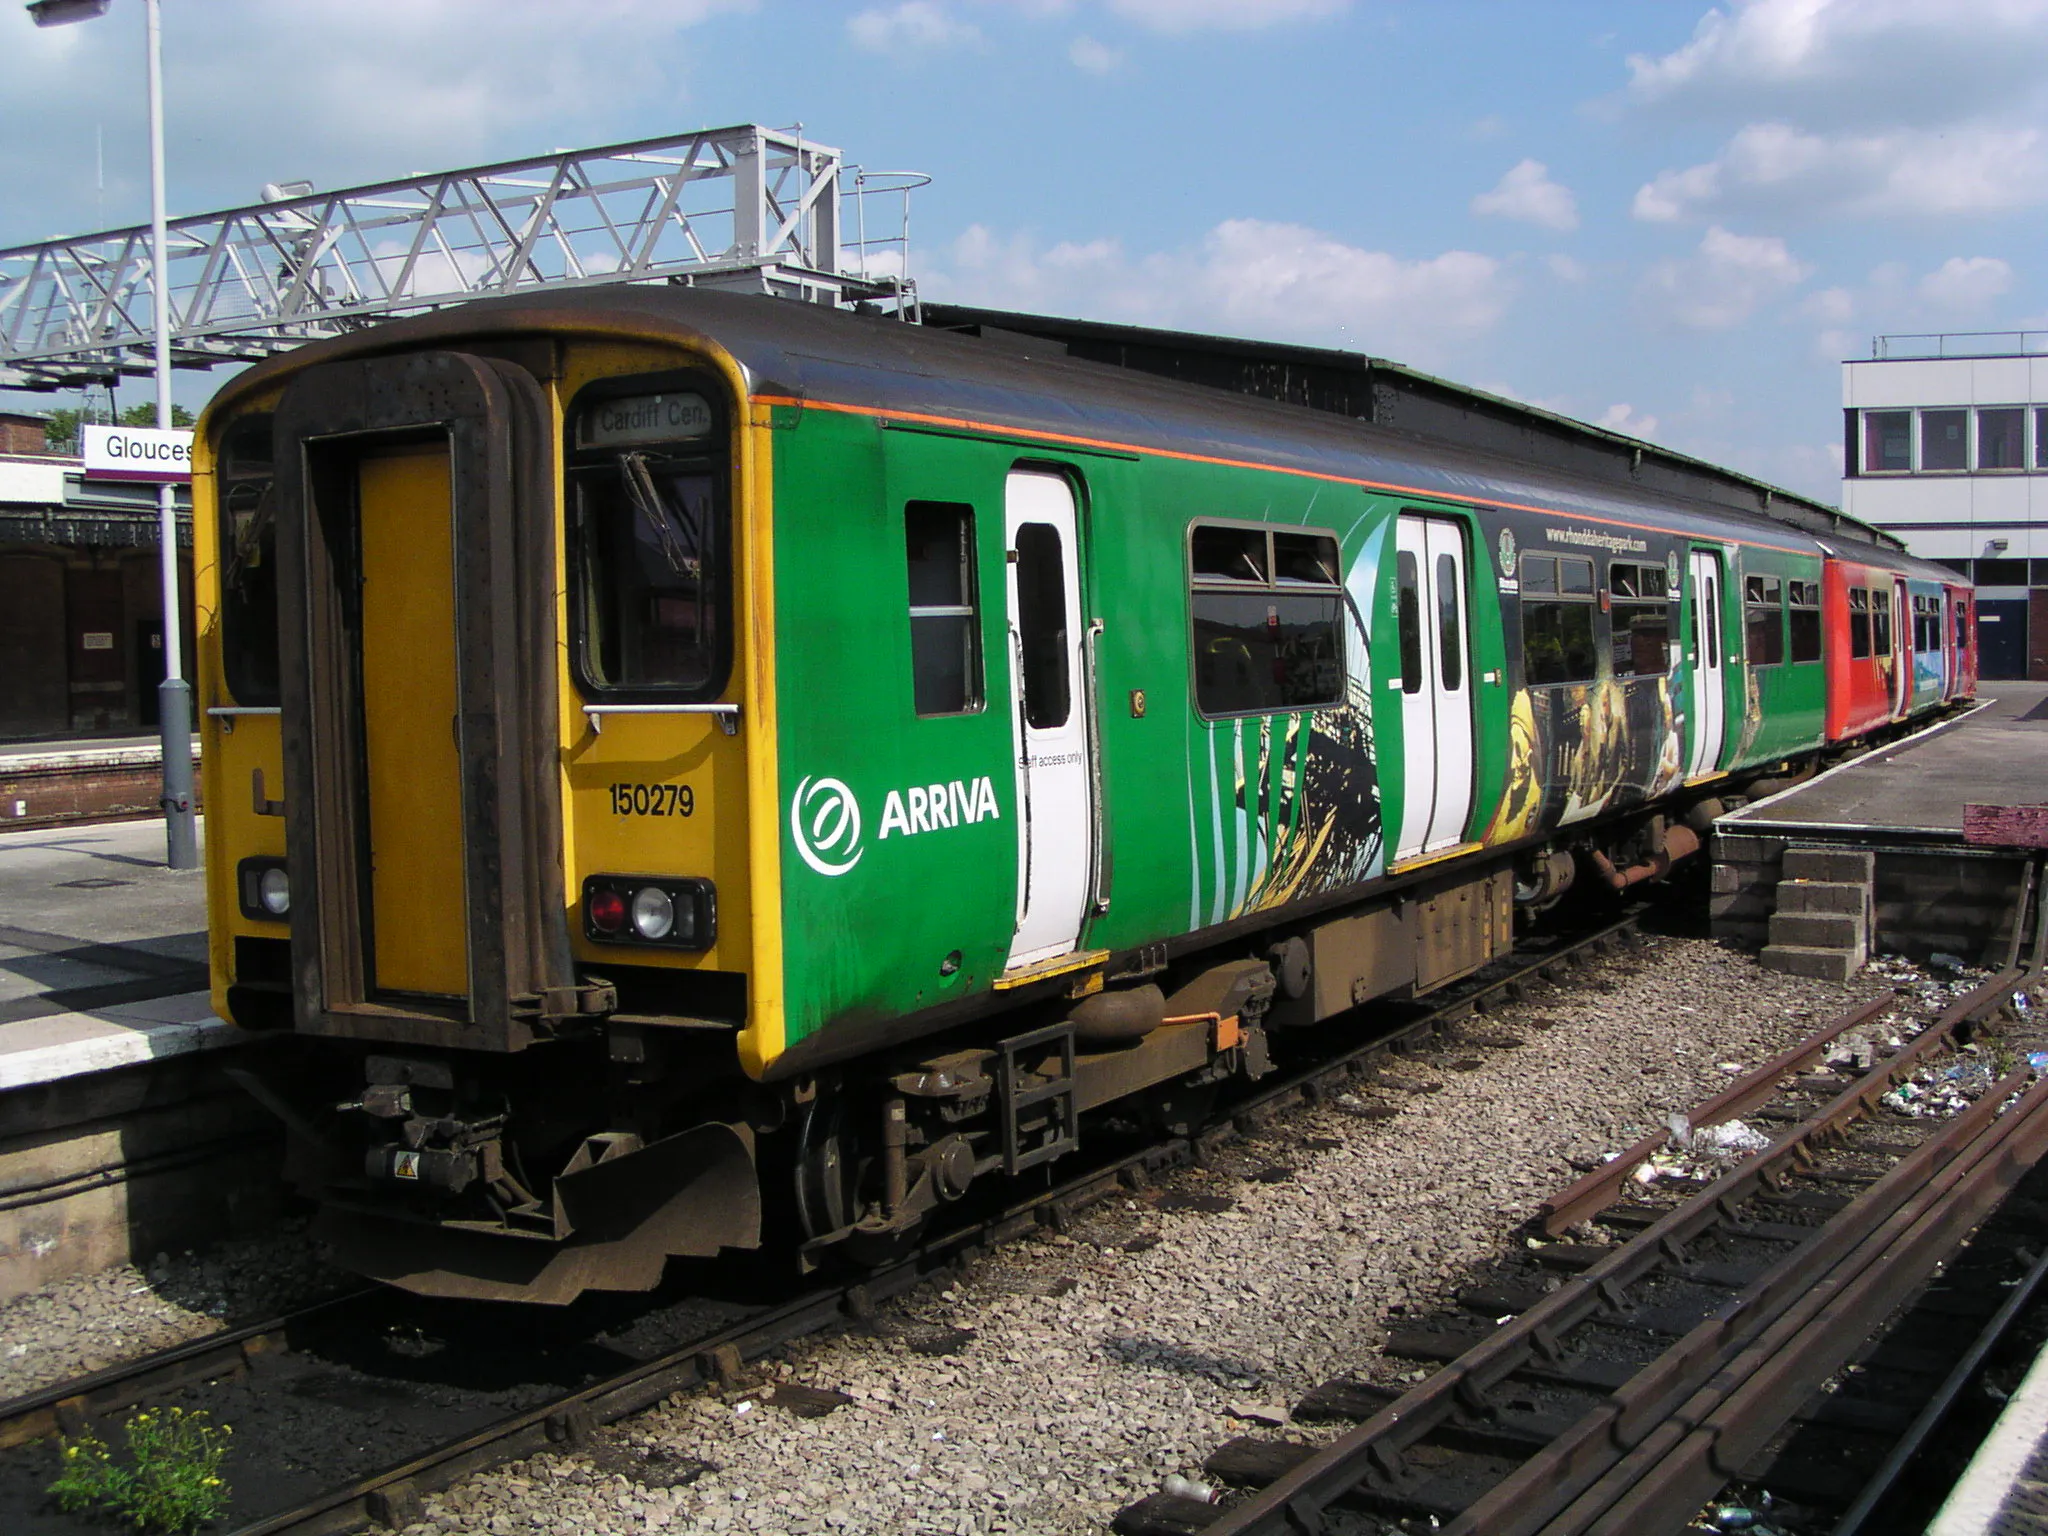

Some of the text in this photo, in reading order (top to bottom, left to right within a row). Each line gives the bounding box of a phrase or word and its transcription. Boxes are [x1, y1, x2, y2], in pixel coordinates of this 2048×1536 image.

[601, 403, 660, 432] Cardiff
[1018, 750, 1082, 770] Saff access only
[609, 783, 694, 817] 150279
[878, 776, 1000, 840] ARRIVA
